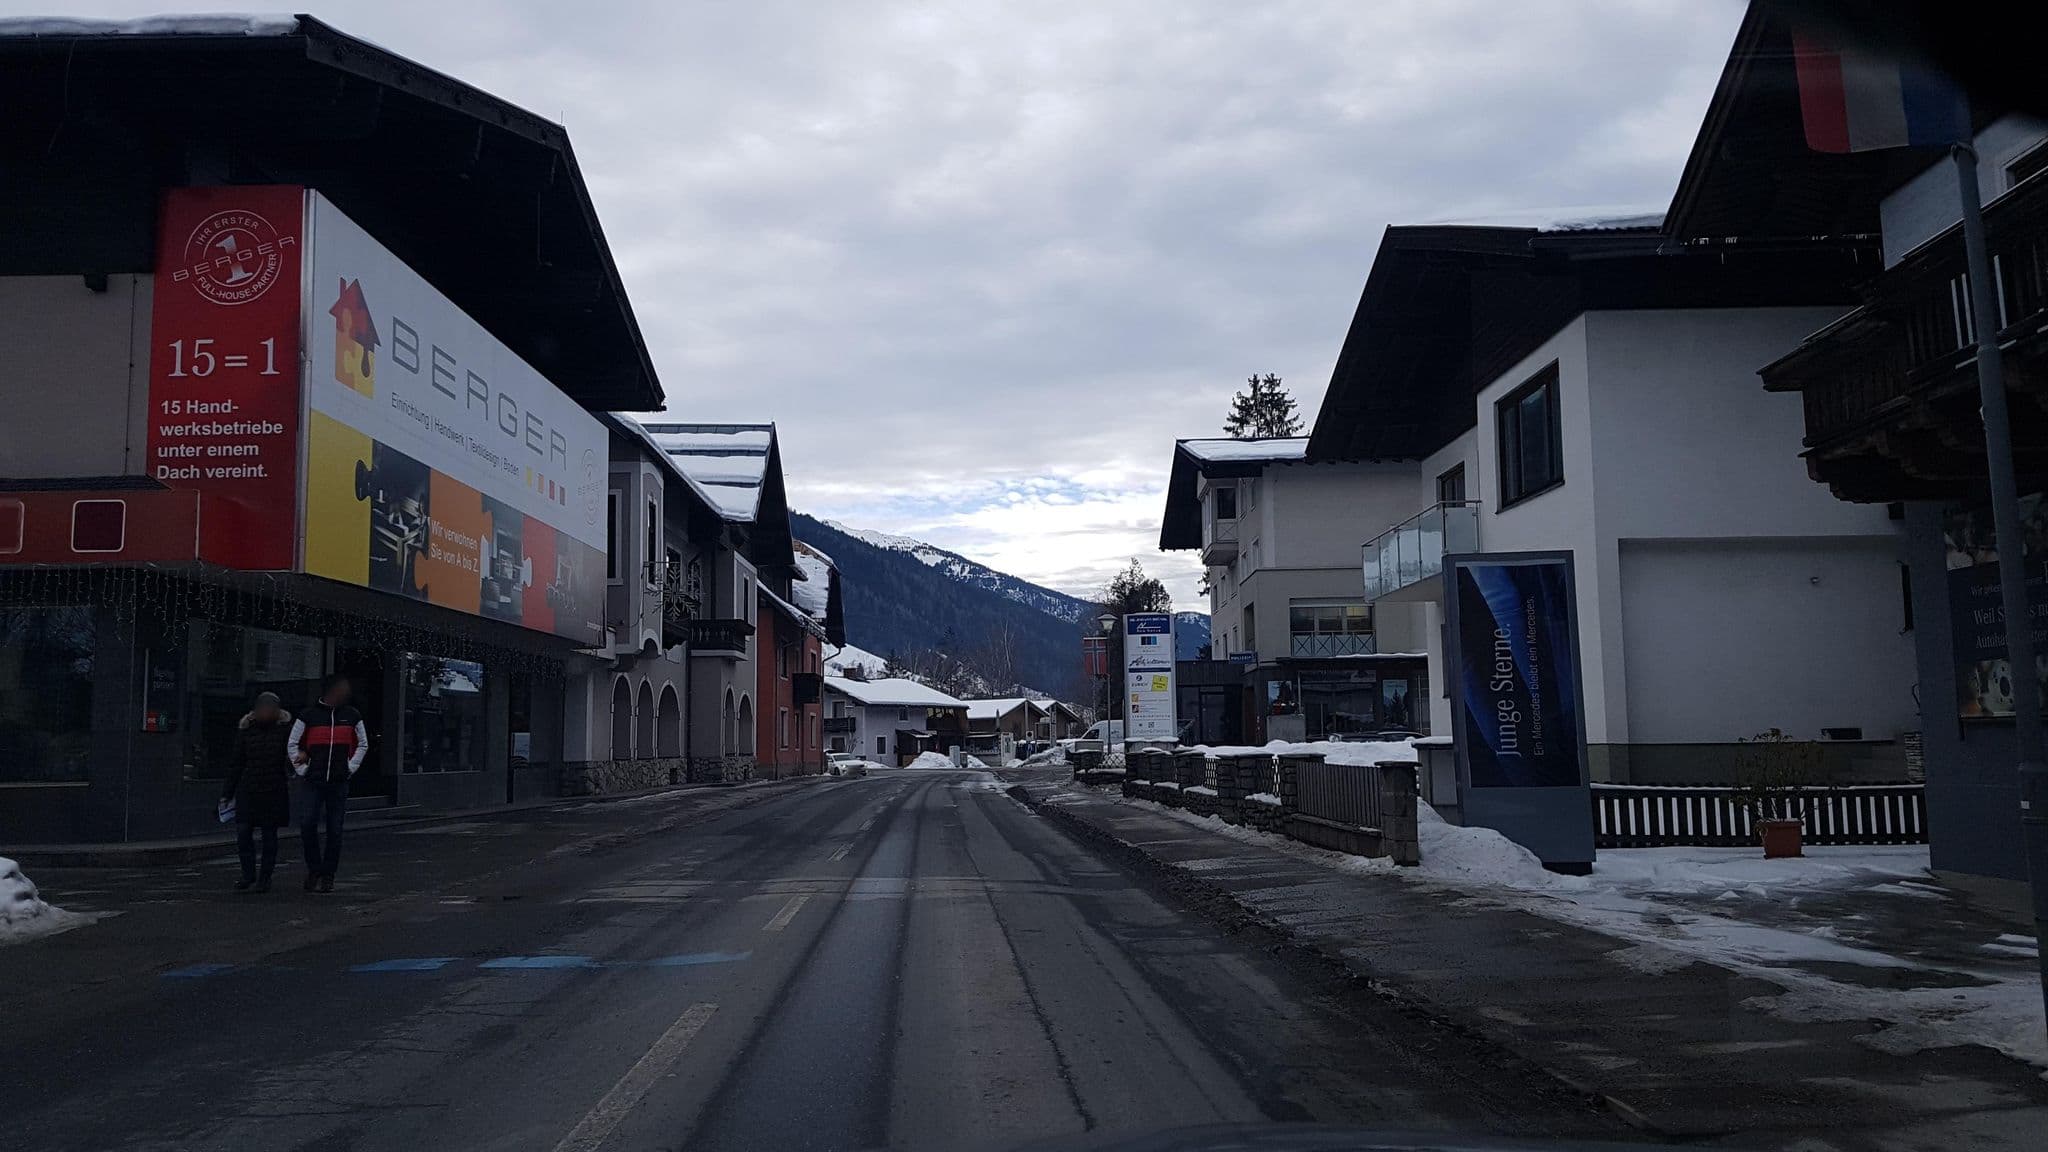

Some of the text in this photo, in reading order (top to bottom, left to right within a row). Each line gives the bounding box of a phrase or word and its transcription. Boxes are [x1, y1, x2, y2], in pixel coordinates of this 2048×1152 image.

[195, 216, 259, 246] IHR ERSTER
[172, 236, 296, 282] BERGER
[197, 253, 278, 301] FULL-HOUSE-PARTNER
[168, 338, 216, 378] 15
[260, 336, 281, 376] 1
[160, 399, 239, 415] 15 Hand-
[391, 316, 567, 472] BERGER
[391, 391, 430, 431] Einrichtung
[160, 420, 283, 437] werksbetriebe
[158, 443, 260, 458] unter einem
[156, 464, 269, 480] Dach vereint.
[431, 520, 443, 536] Wir
[431, 543, 442, 560] Sie
[443, 551, 456, 565] von
[456, 552, 462, 567] A
[463, 554, 473, 571] bis
[1527, 647, 1538, 662] ein
[1490, 623, 1522, 757] Junge Sterne.
[1528, 664, 1539, 690] bleibt
[1529, 692, 1542, 739] Mercedes
[1533, 741, 1544, 756] Ein
